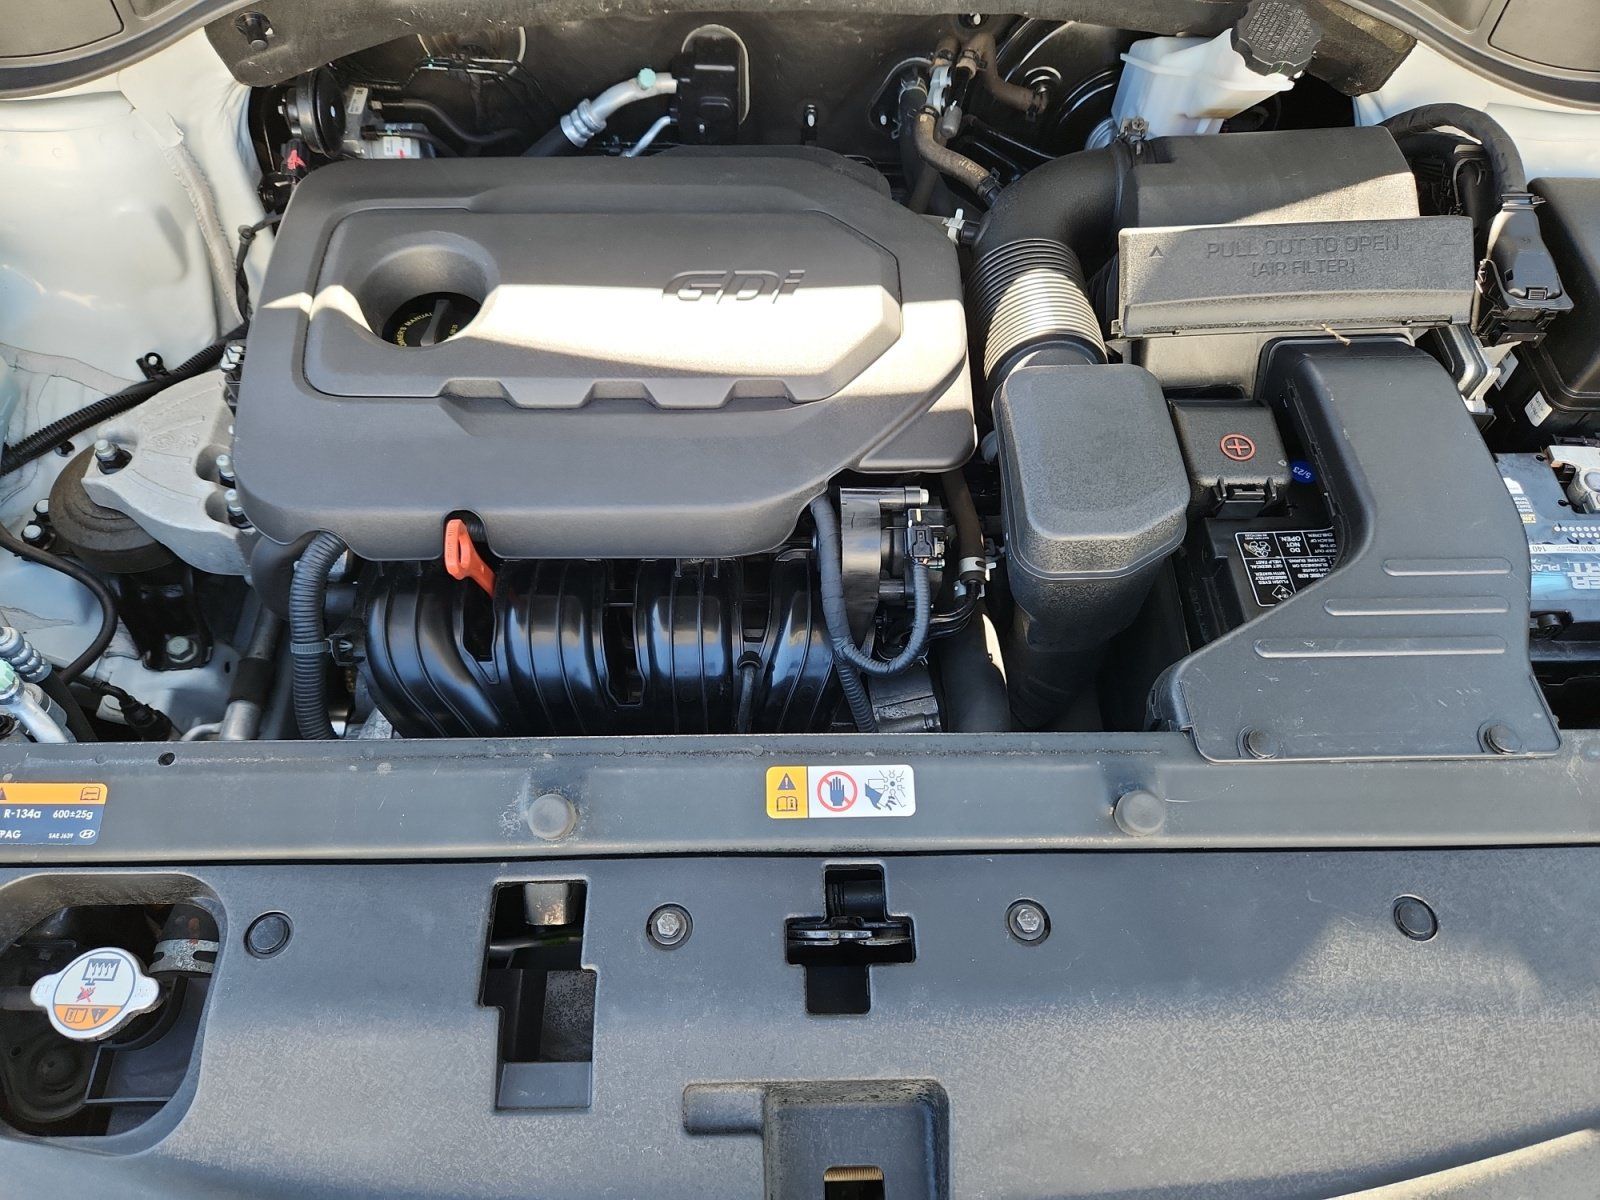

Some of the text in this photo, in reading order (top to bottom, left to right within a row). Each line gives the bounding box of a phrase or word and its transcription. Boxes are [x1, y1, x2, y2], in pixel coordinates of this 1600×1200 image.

[1206, 235, 1399, 258] PULL OUT TO OPEN
[1292, 466, 1312, 479] 5/23
[3, 808, 94, 820] R-134a 600±25g
